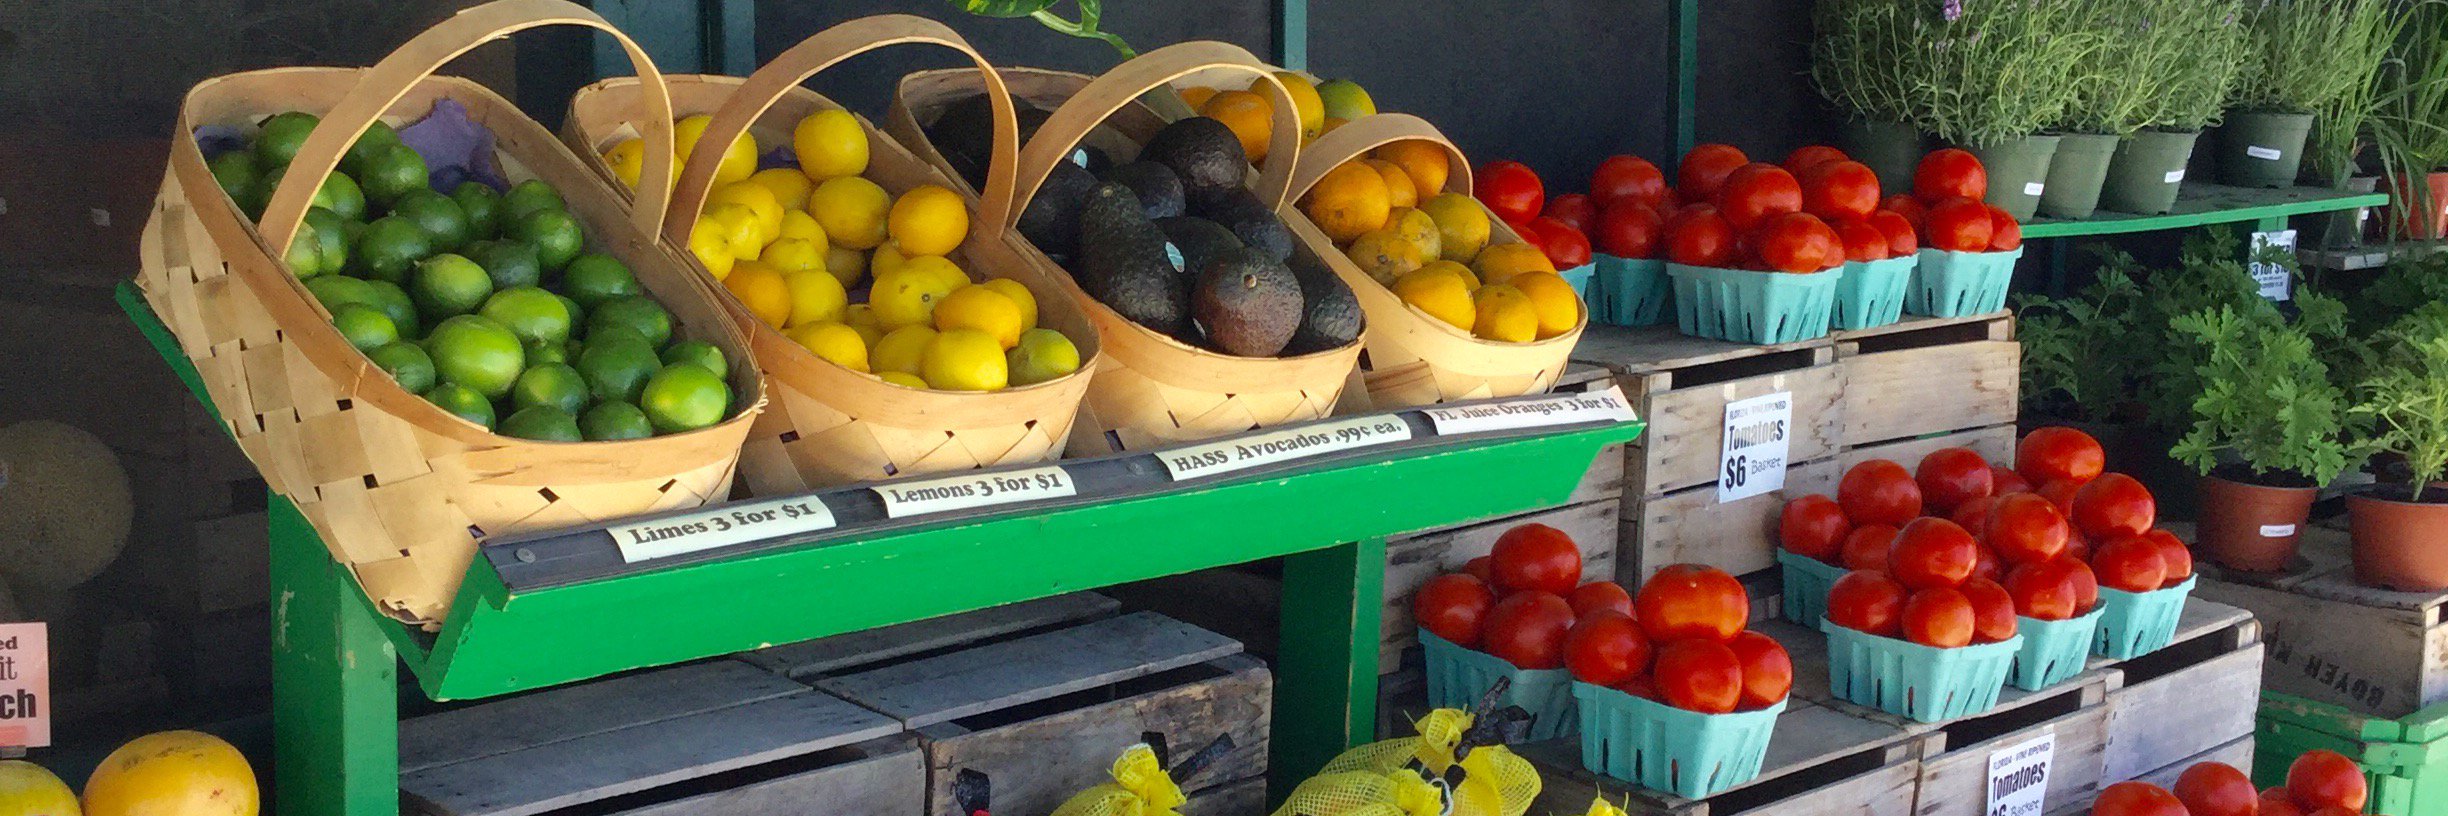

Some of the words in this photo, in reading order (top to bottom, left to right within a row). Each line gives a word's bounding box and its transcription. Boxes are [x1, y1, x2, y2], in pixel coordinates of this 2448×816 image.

[1434, 410, 1458, 422] FL
[1461, 406, 1500, 419] Juice
[1500, 401, 1564, 416] Oranges
[1565, 400, 1578, 412] 3
[1577, 398, 1601, 409] for
[1601, 397, 1622, 410] $1
[1173, 450, 1229, 472] HASS
[1235, 432, 1331, 461] Avocados
[1336, 425, 1371, 443] .99¢
[1374, 420, 1402, 434] ea.
[1729, 420, 1784, 451] Tomatoes
[889, 483, 975, 504] Lemons
[975, 480, 994, 497] 3
[993, 476, 1031, 493] for
[1035, 473, 1063, 491] $1
[1725, 455, 1746, 492] $6
[1751, 457, 1781, 474] Basket
[628, 521, 708, 544] Limes
[710, 517, 732, 532] 3
[732, 509, 777, 526] for
[781, 503, 817, 520] $1
[1993, 761, 2046, 803] Tomatoes
